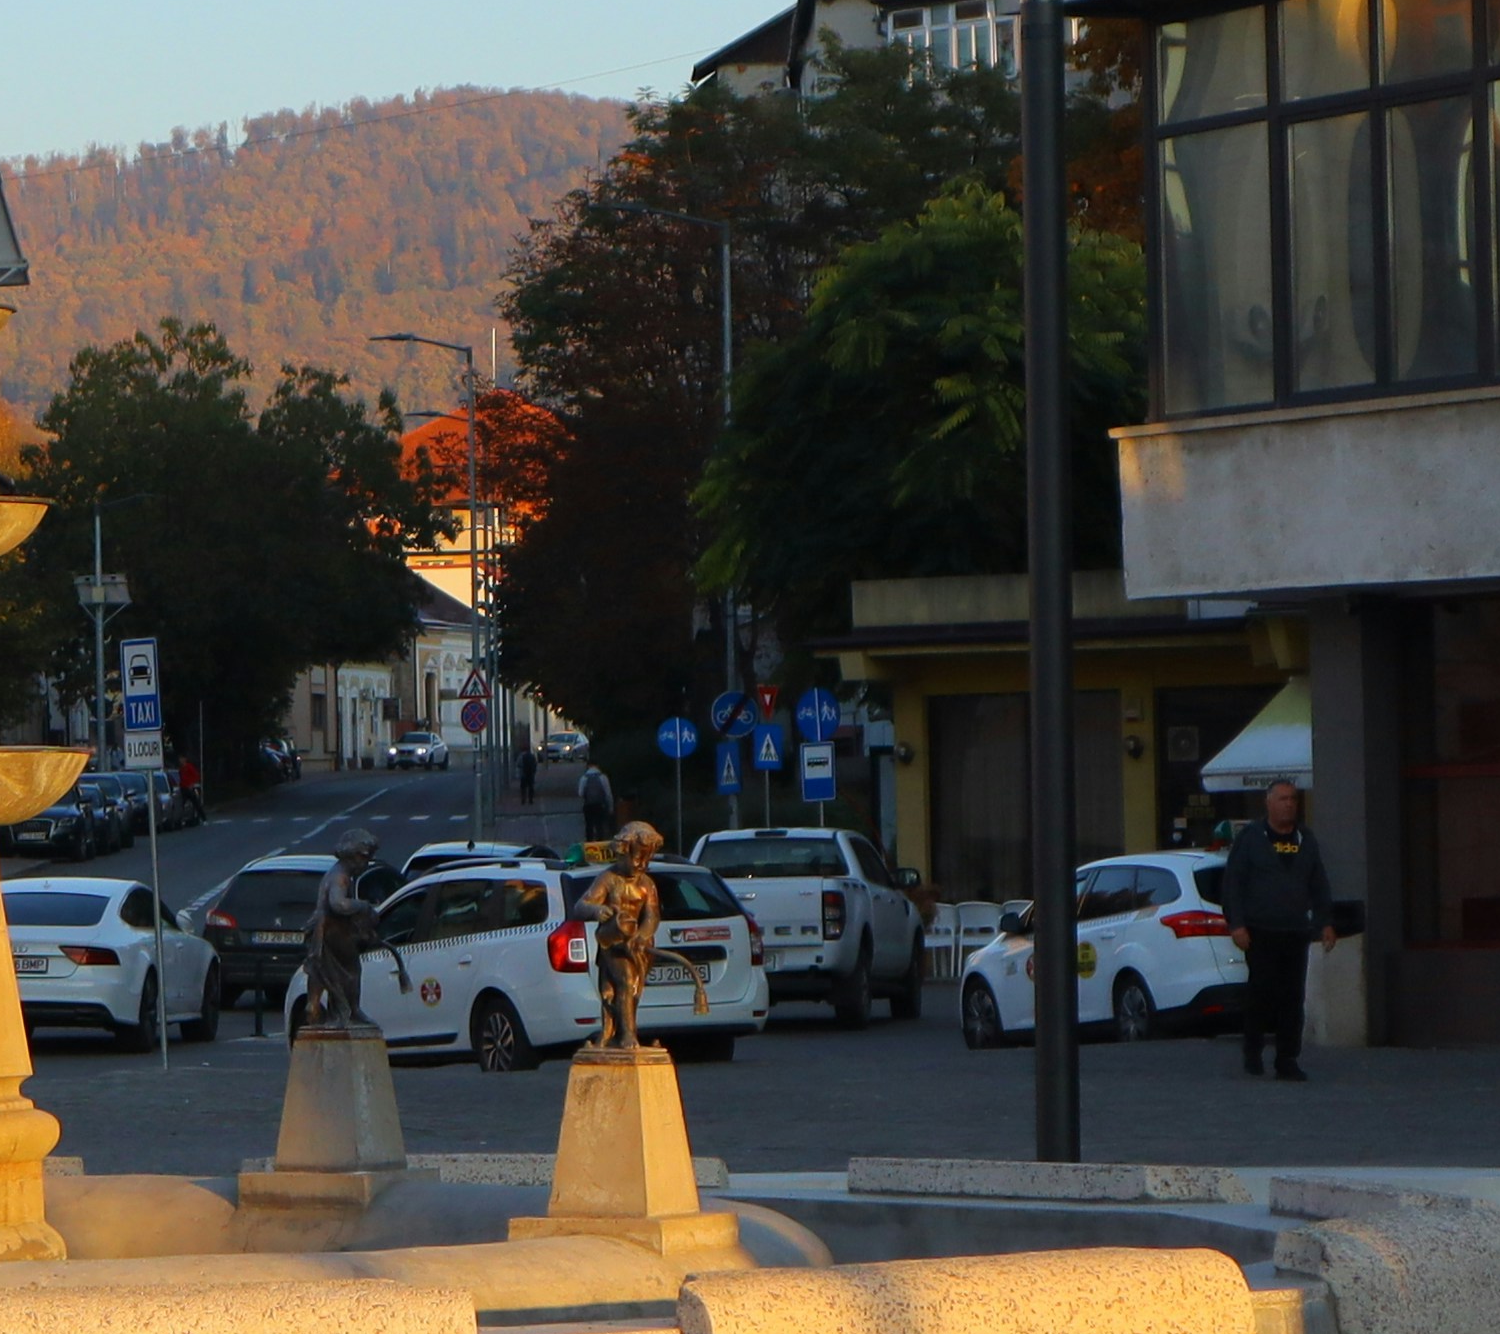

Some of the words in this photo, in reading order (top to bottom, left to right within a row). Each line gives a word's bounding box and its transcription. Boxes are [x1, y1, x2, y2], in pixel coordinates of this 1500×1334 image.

[129, 700, 155, 724] TAXI
[127, 742, 132, 758] 9
[133, 740, 160, 757] LOCURI
[648, 968, 664, 982] SJ
[666, 967, 681, 981] 20
[682, 966, 706, 980] RS
